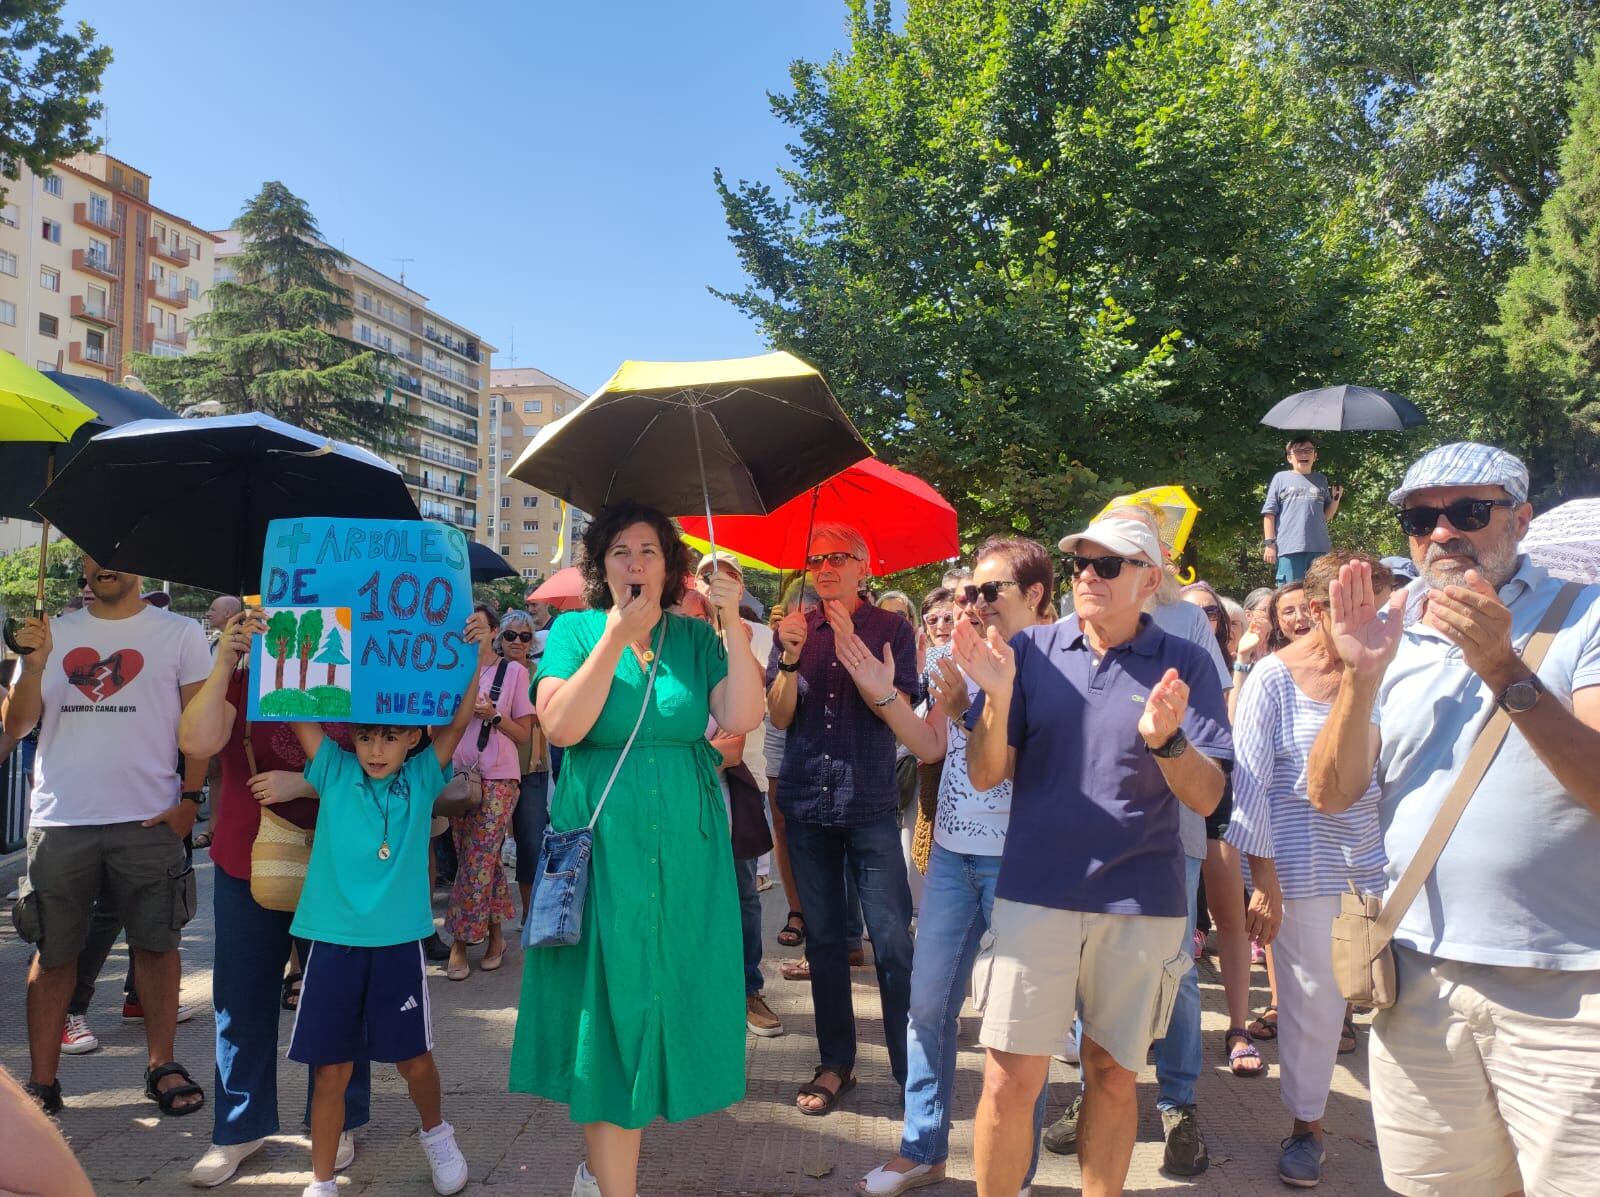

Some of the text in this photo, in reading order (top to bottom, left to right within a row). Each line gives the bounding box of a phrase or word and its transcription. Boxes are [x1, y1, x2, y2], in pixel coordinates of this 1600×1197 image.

[316, 524, 465, 570] ARBOLES
[266, 567, 453, 626] DE 100
[60, 704, 94, 713] SALVEMOS
[95, 705, 117, 713] CANAL
